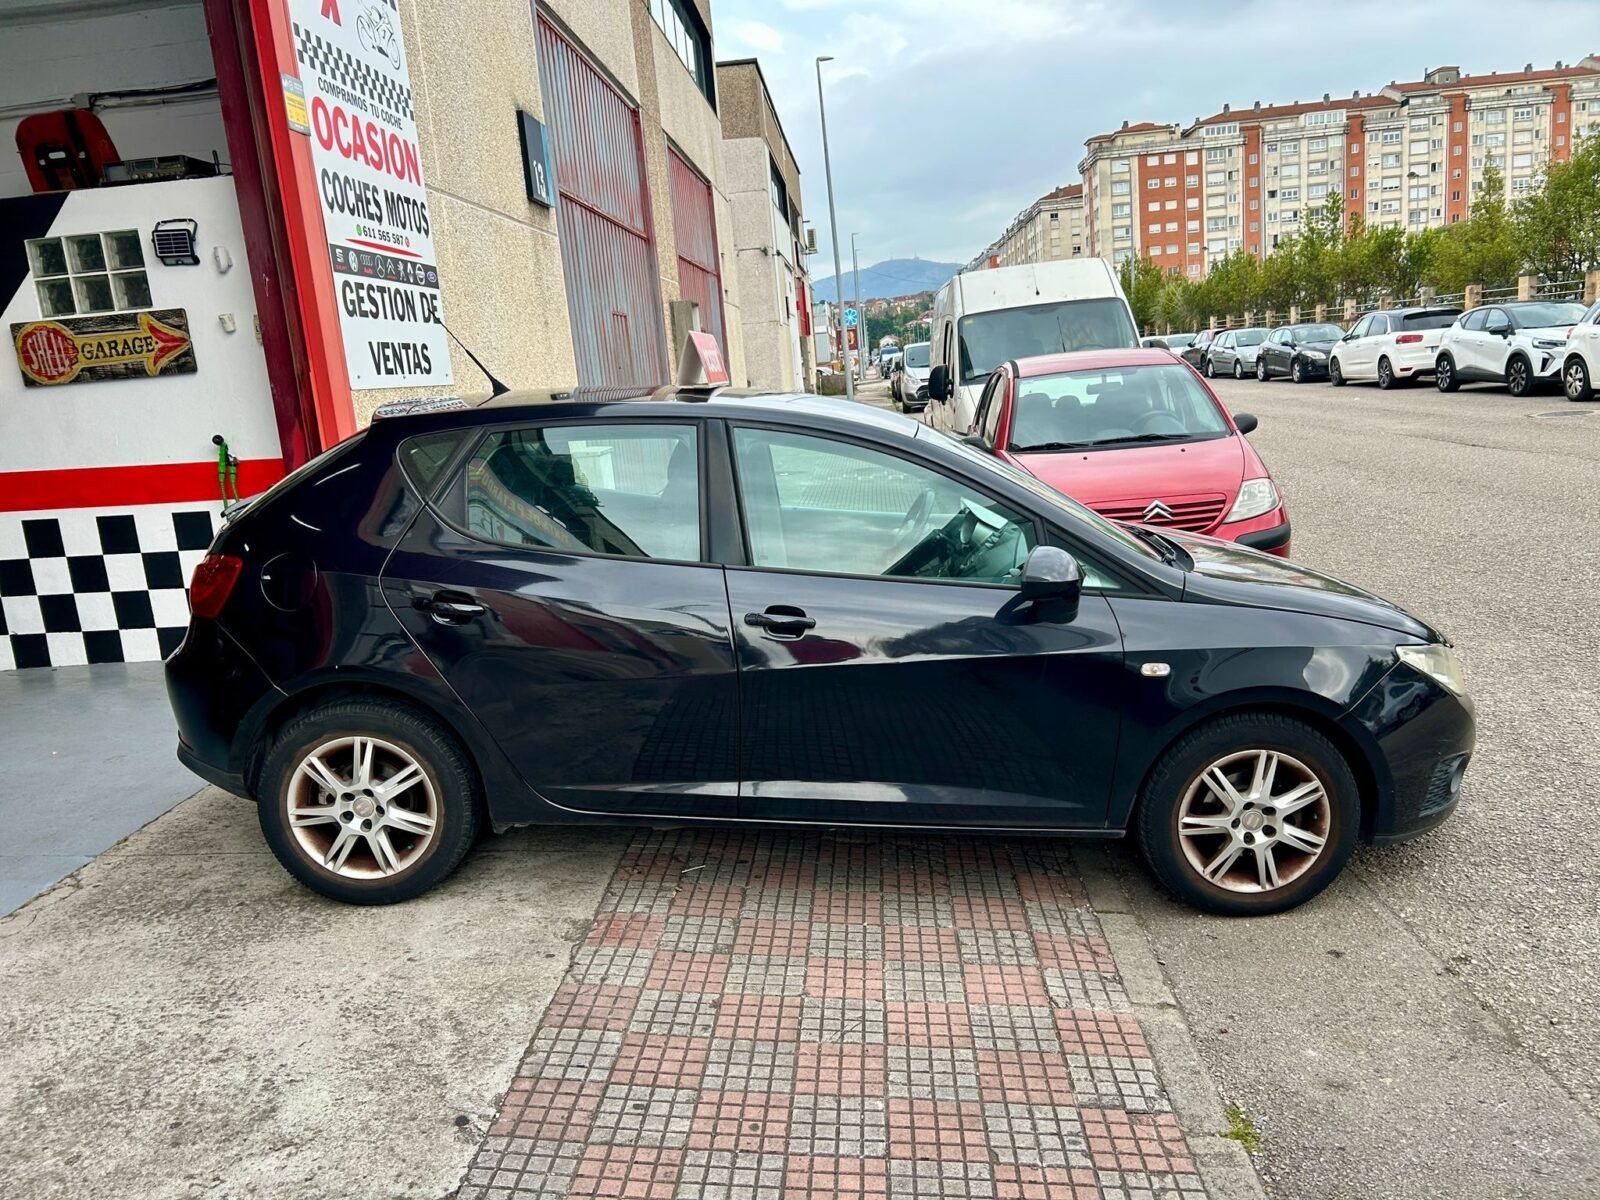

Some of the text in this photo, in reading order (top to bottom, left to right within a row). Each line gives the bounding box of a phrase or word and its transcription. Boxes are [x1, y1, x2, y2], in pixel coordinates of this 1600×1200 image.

[317, 78, 368, 112] COMPRAMOS
[370, 103, 380, 119] TU
[380, 108, 403, 130] COCHE
[311, 96, 421, 187] OCASION
[533, 160, 547, 198] 13
[321, 168, 430, 239] COCHES MOTOS
[362, 225, 404, 247] 611 565 587
[341, 279, 441, 324] GESTION DE
[27, 330, 155, 376] SHELL GARAGE
[368, 341, 432, 376] VENTAS
